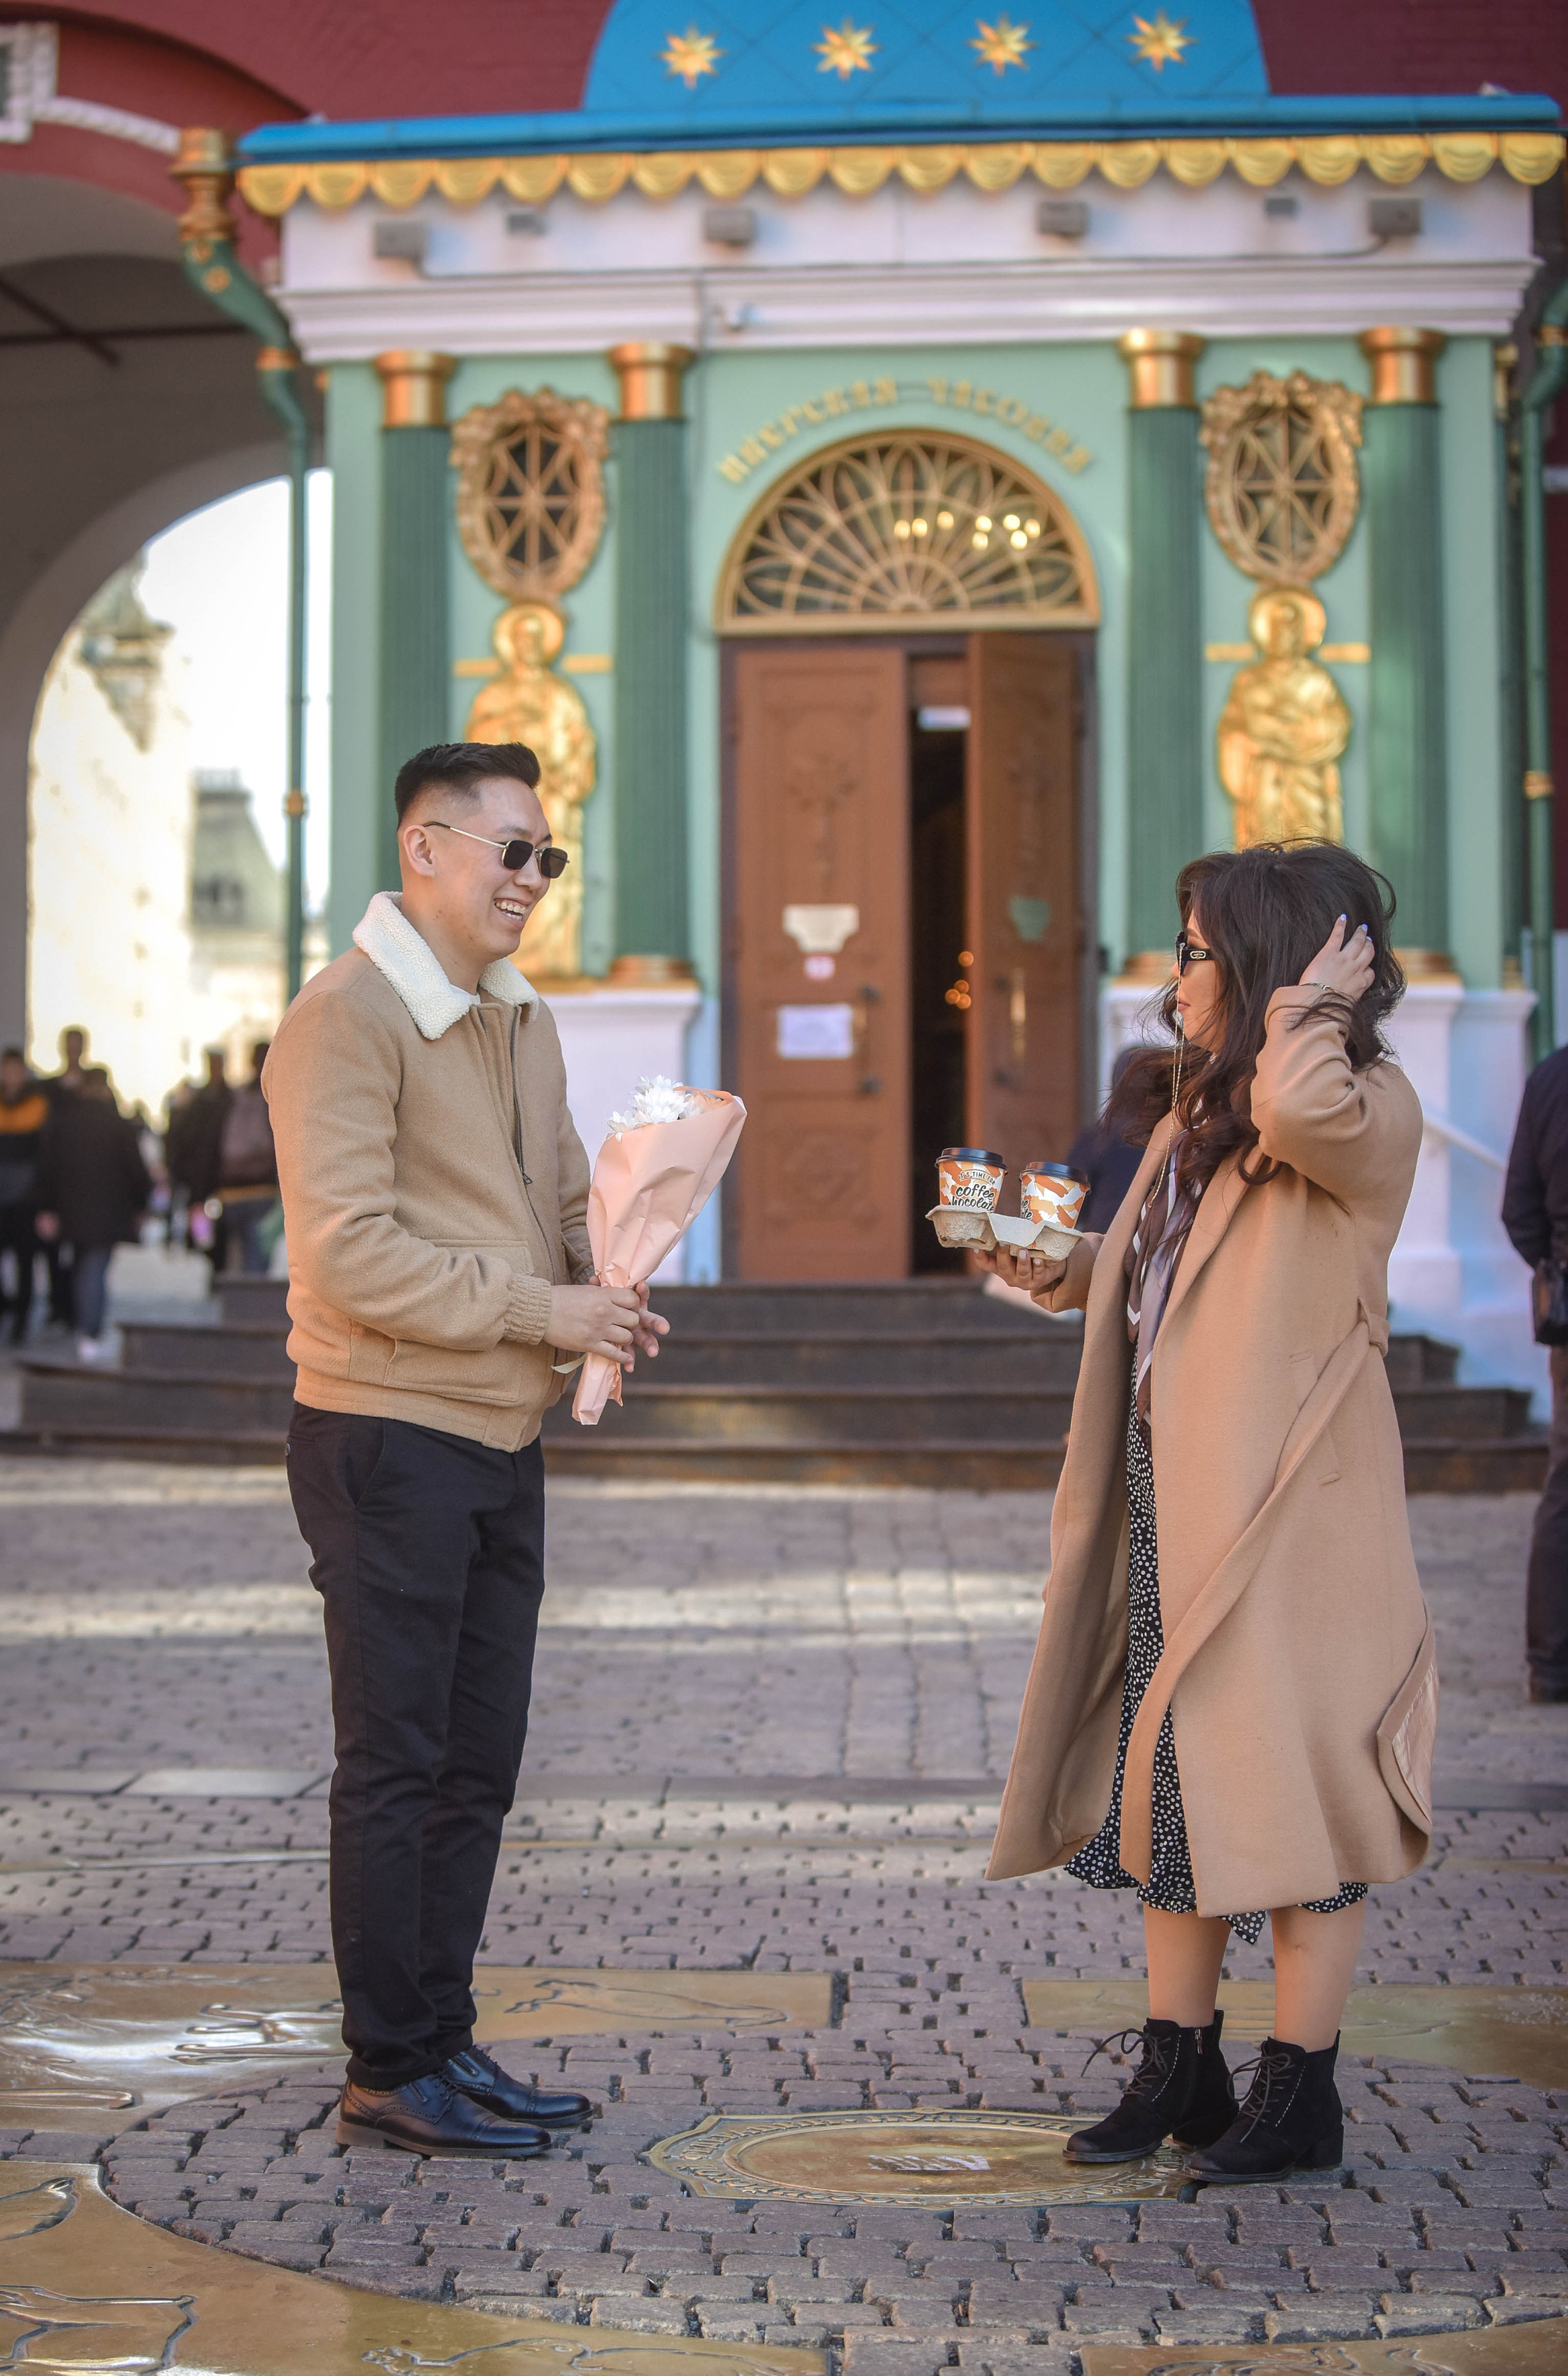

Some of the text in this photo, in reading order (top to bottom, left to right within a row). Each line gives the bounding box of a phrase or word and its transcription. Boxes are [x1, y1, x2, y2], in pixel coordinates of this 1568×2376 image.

[958, 1171, 996, 1185] IT'S TIME FOR
[956, 1183, 994, 1201] coffee
[948, 1196, 994, 1213] hocolate
[866, 2114, 1074, 2130] НУЛЕВОЙ
